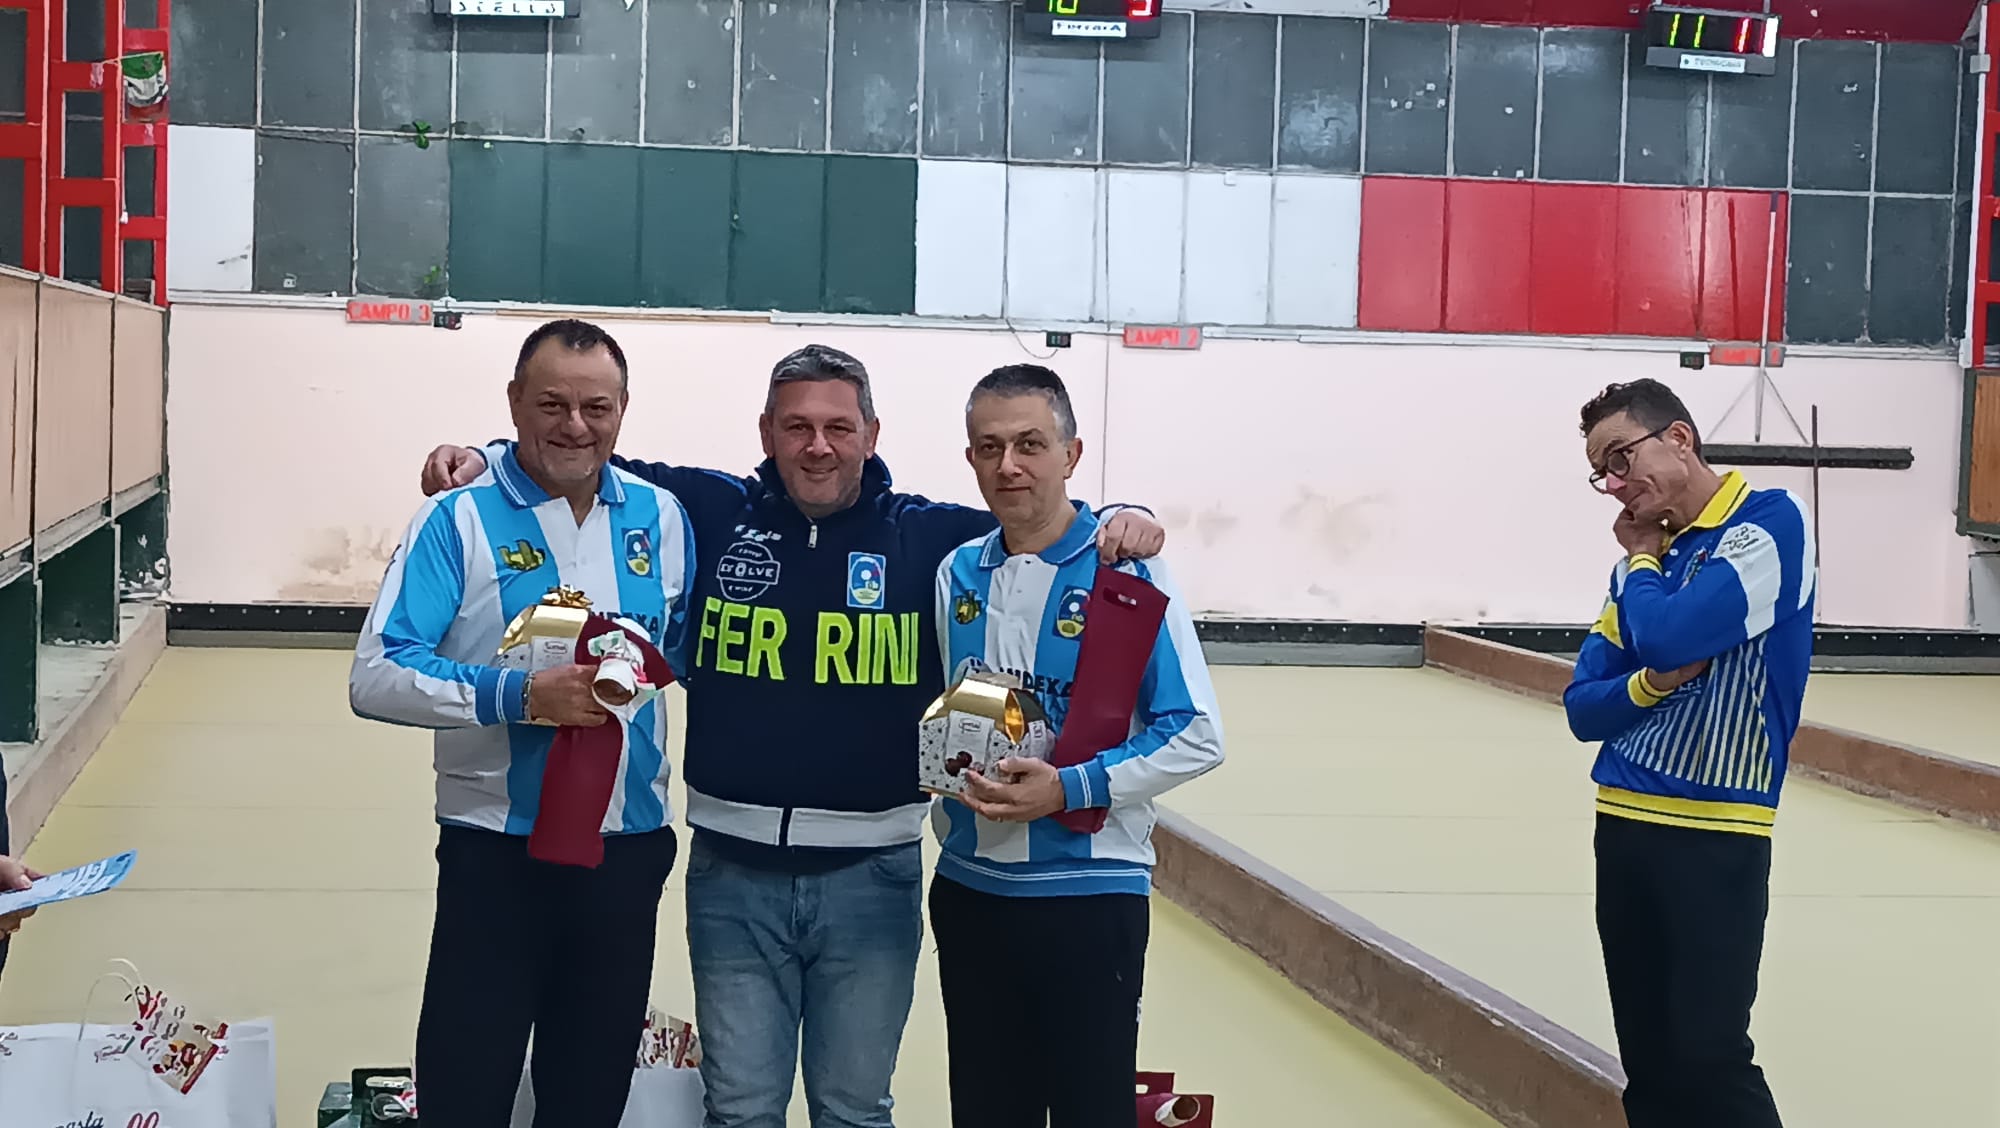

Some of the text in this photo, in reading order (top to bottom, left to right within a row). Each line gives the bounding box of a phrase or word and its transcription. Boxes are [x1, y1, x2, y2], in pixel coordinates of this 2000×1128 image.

[349, 302, 429, 321] CAMPO 3
[1125, 326, 1180, 345] CAMPO
[696, 597, 787, 680] FER
